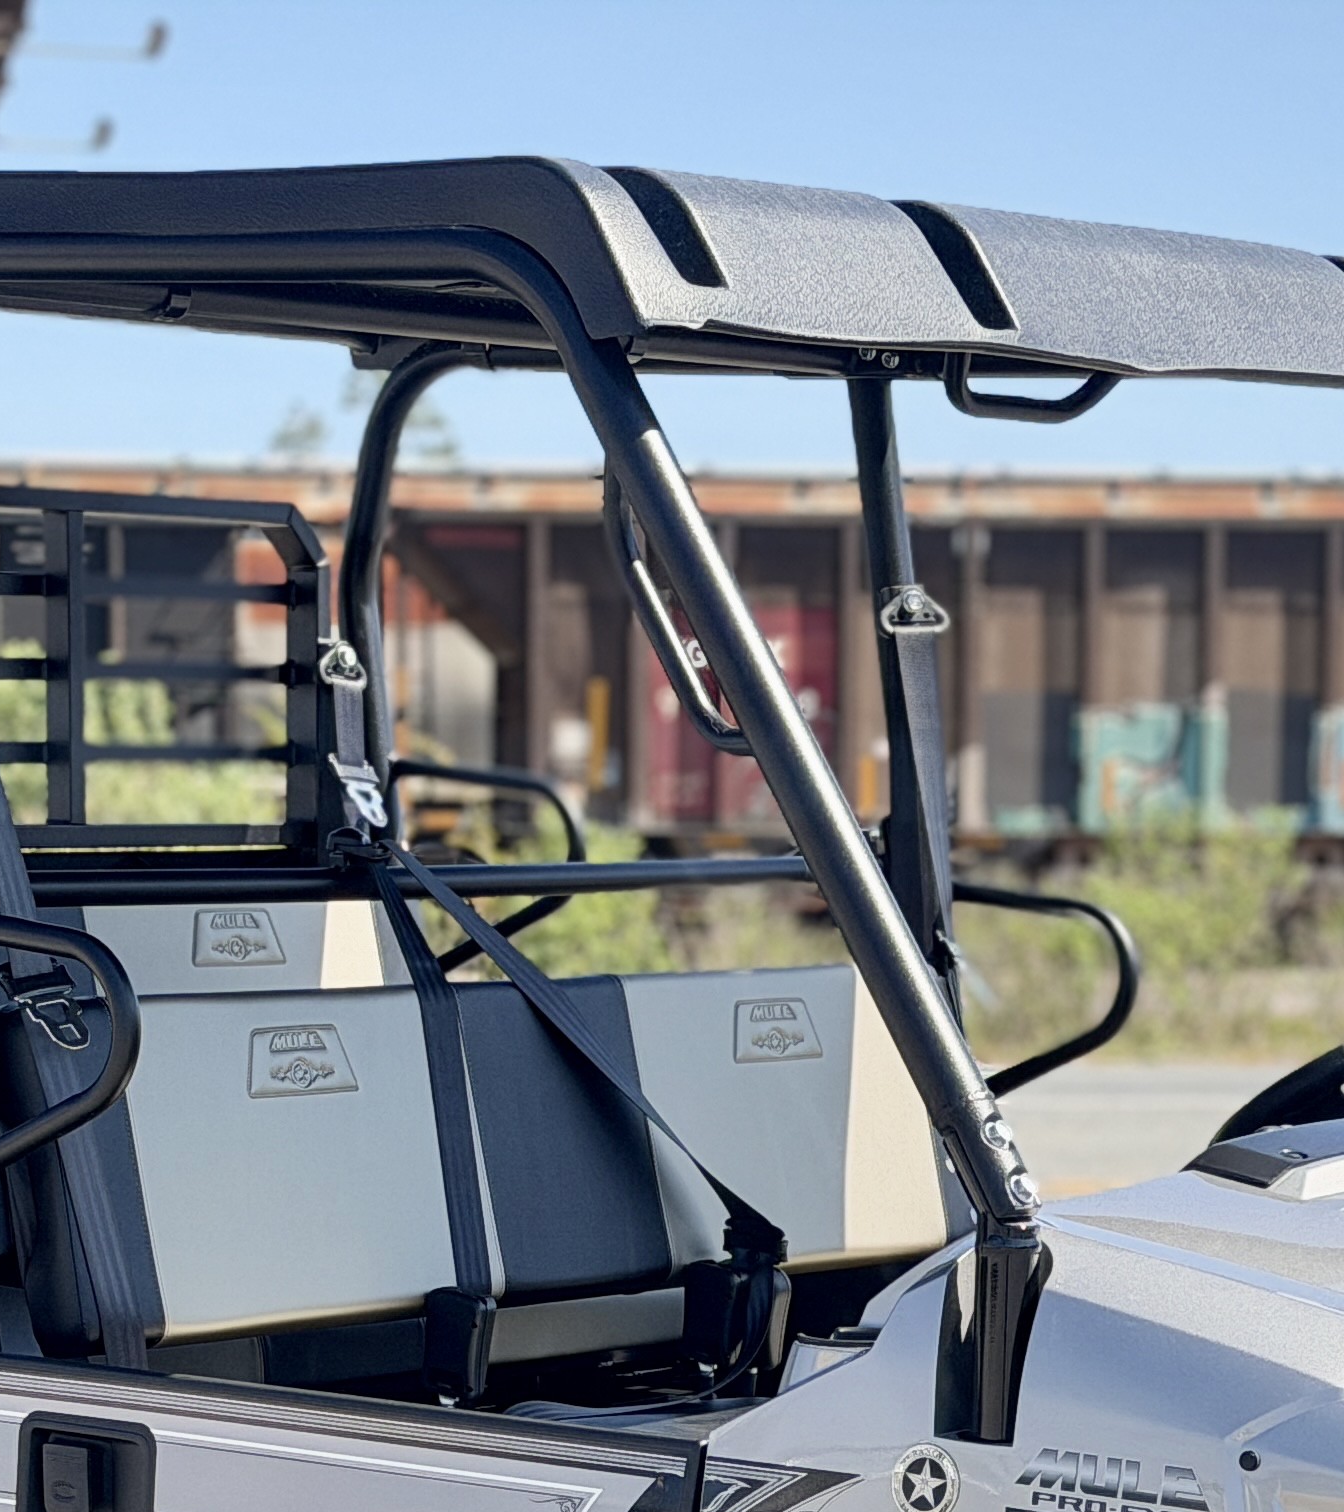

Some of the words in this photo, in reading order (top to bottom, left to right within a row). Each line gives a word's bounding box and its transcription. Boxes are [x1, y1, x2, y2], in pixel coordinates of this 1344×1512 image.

[211, 912, 260, 929] MULE
[750, 1003, 797, 1022] MULE
[269, 1031, 327, 1053] MULE
[1015, 1447, 1211, 1512] MULE
